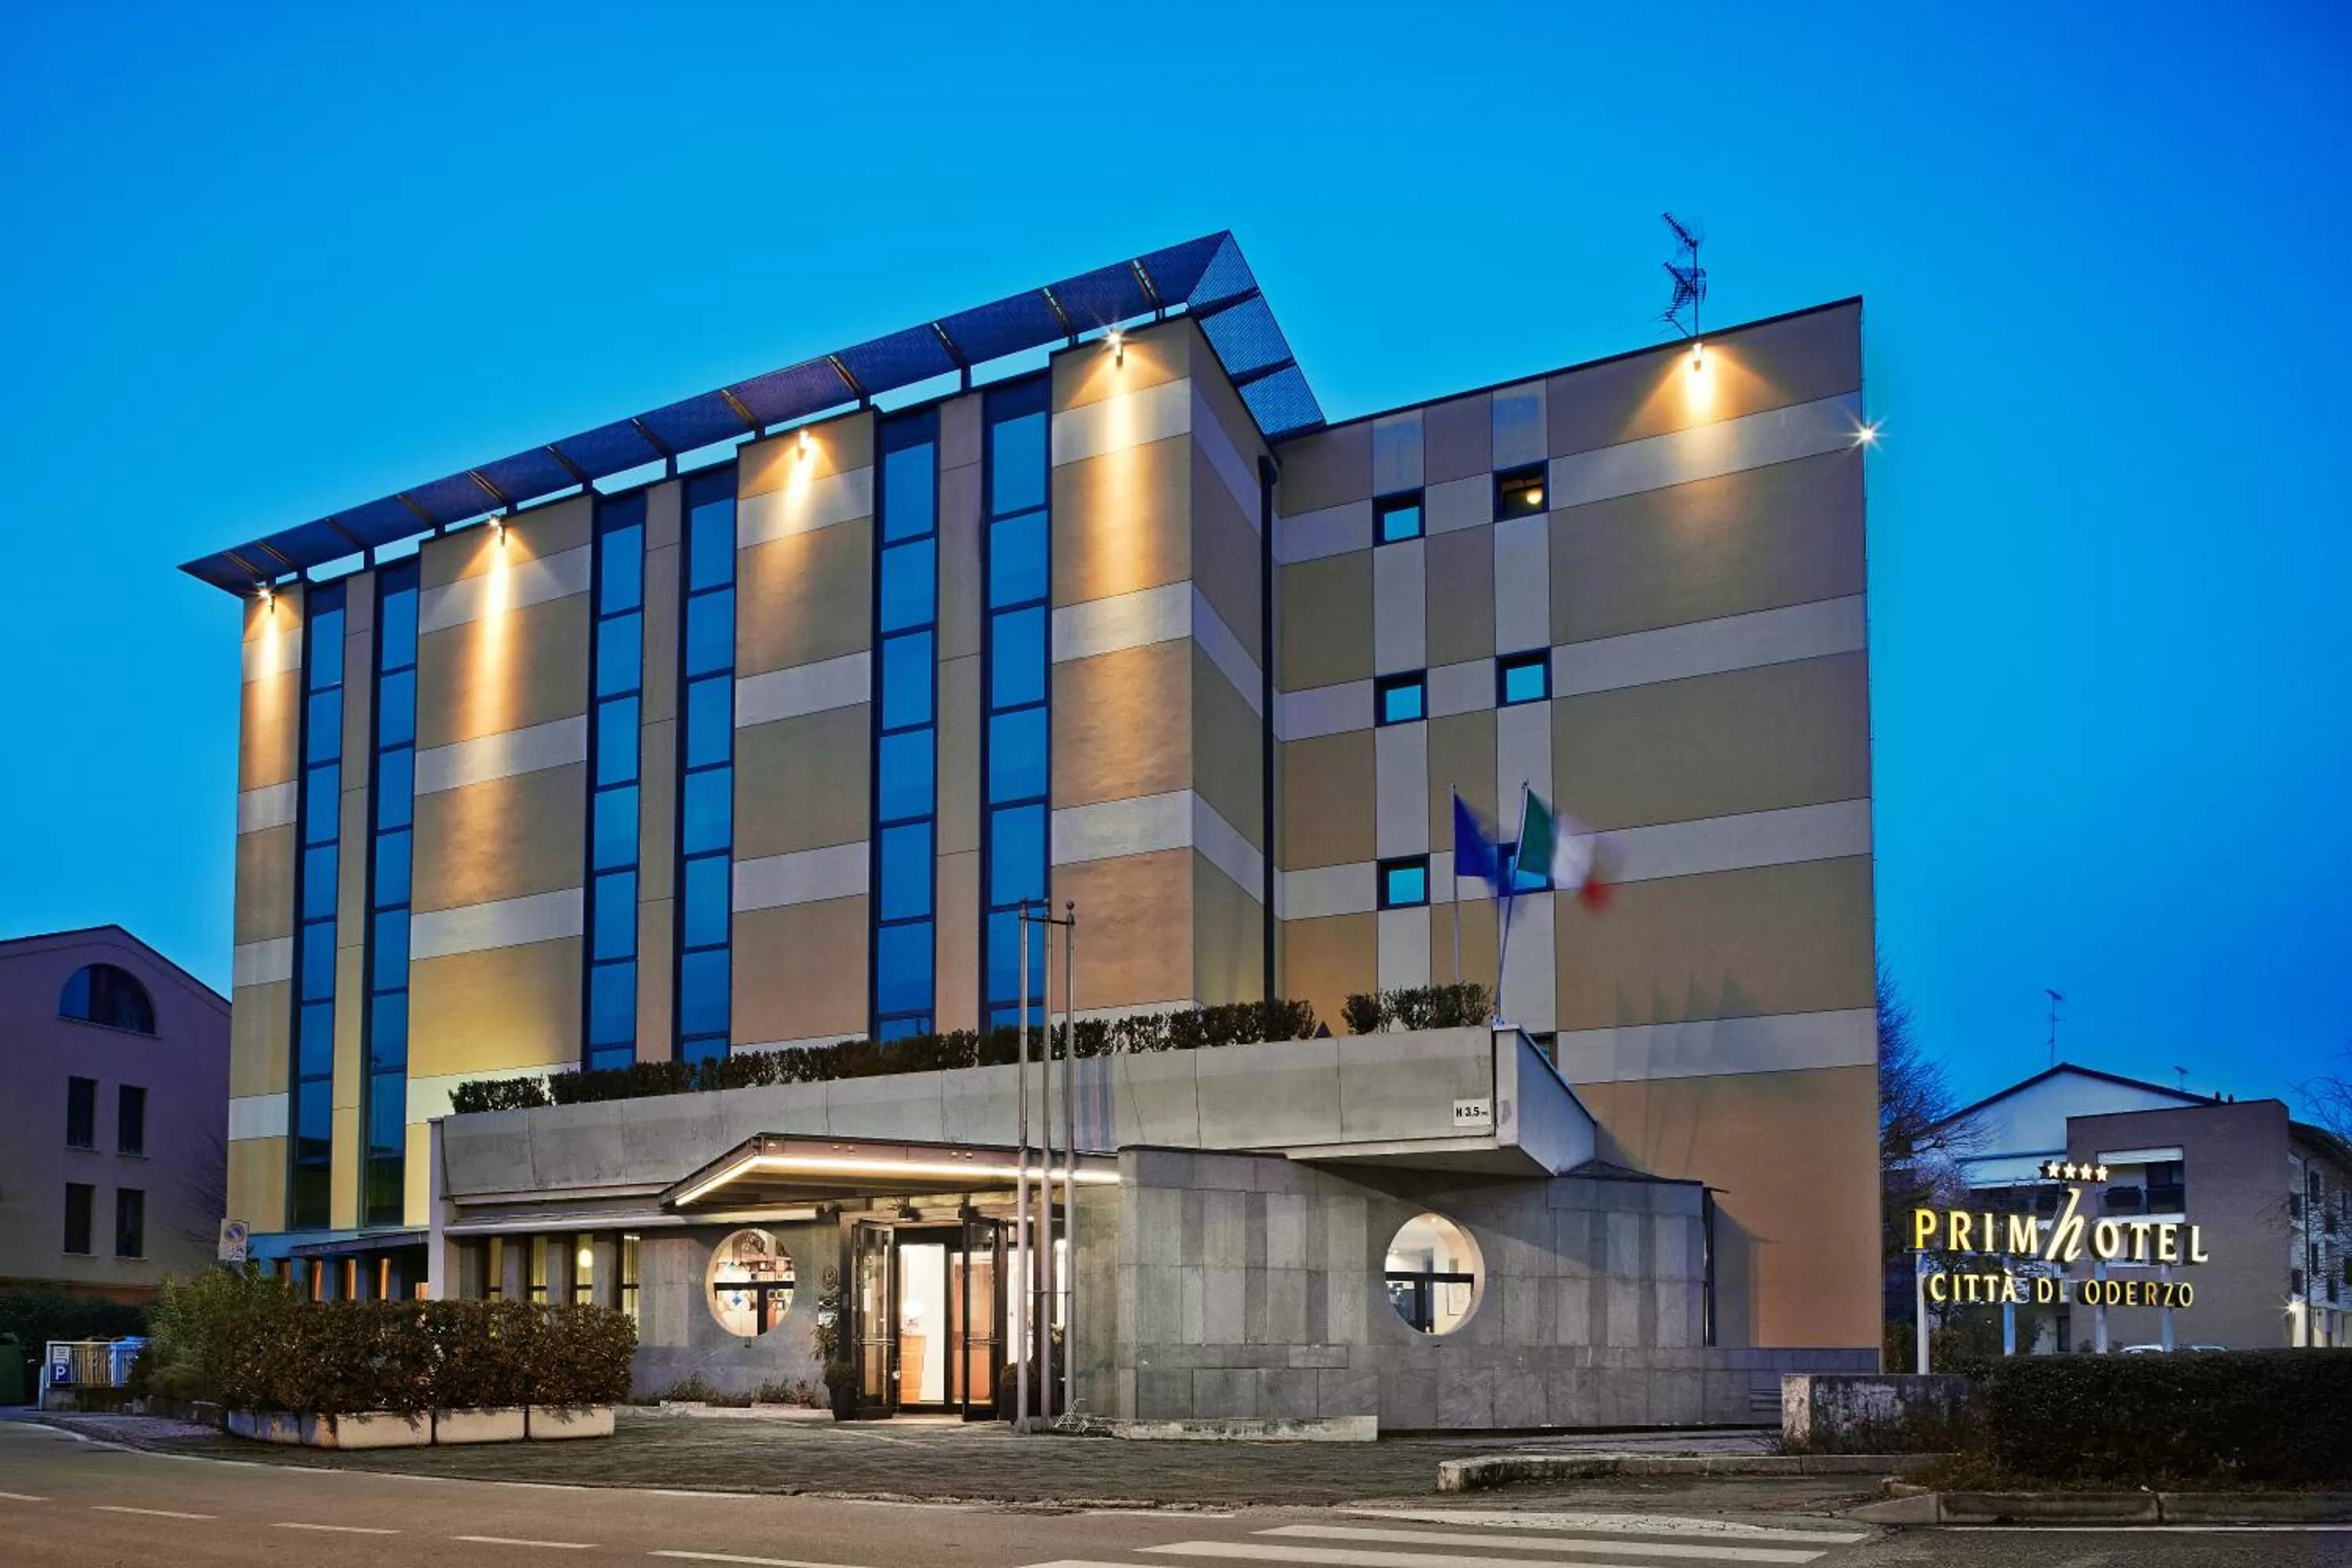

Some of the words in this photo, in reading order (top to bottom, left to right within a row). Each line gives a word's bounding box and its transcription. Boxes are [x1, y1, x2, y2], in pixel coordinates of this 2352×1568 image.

[1456, 1107, 1462, 1117] H
[1929, 1267, 2018, 1302] CITTÀ
[2038, 1279, 2066, 1303] DI
[2085, 1279, 2194, 1308] ODERZO
[56, 1365, 67, 1381] P
